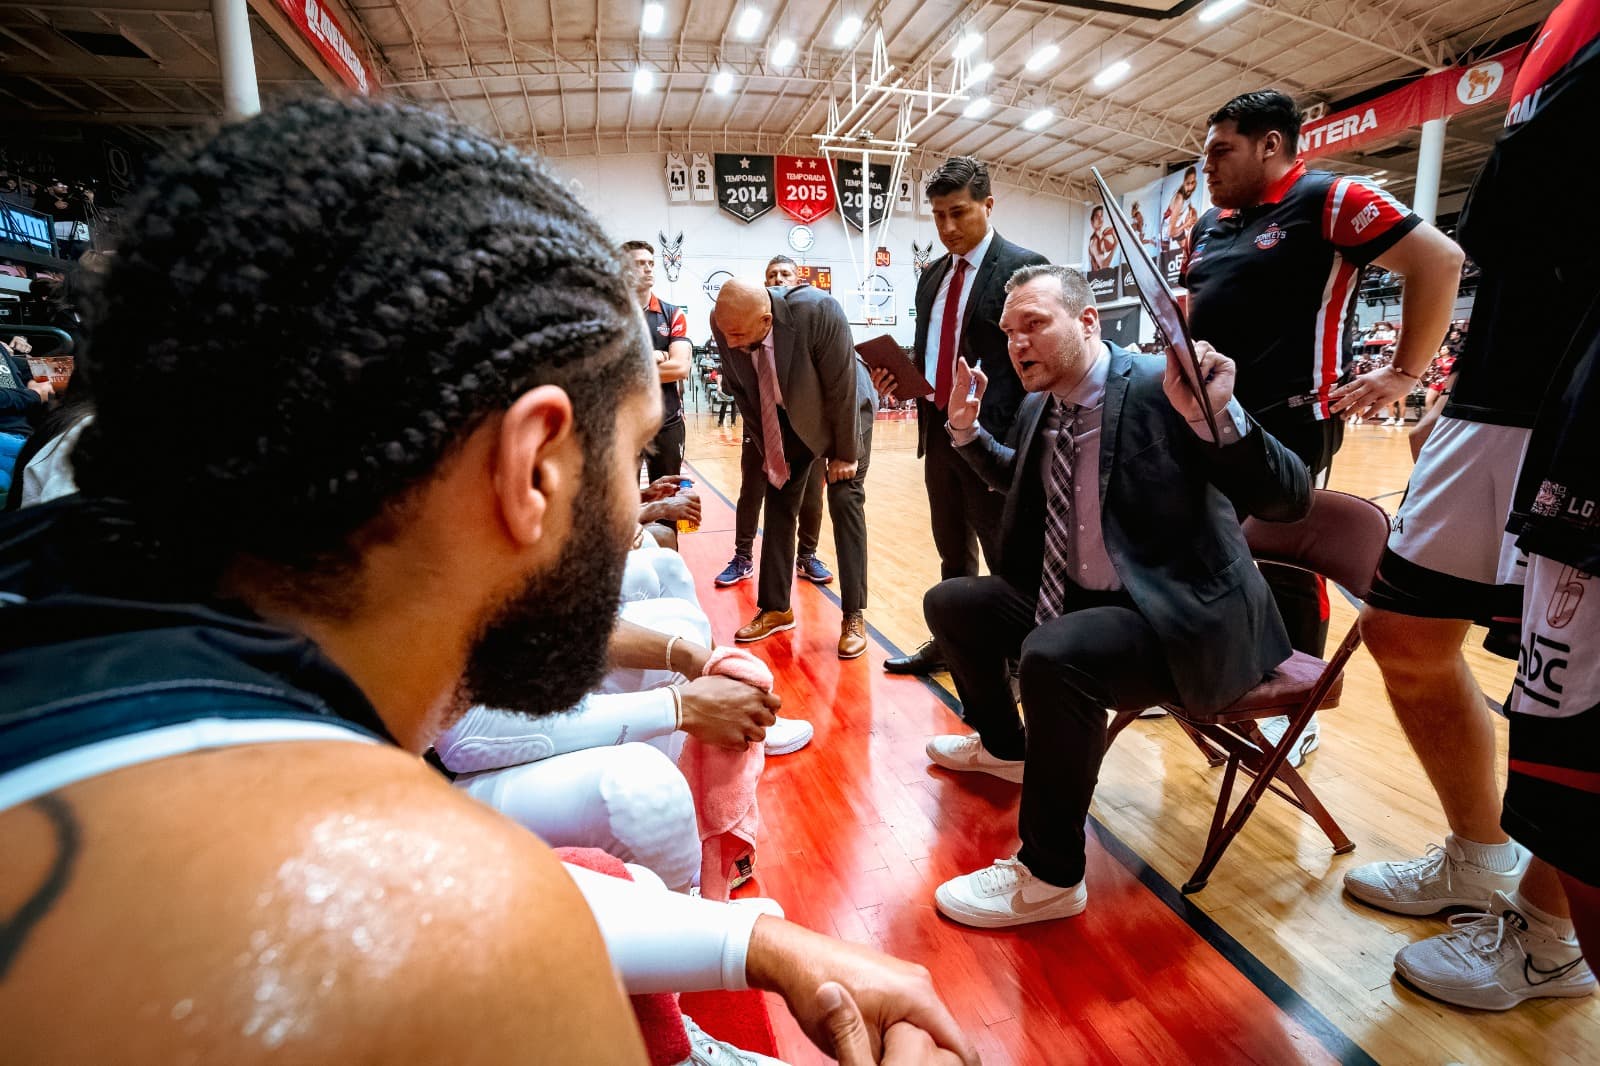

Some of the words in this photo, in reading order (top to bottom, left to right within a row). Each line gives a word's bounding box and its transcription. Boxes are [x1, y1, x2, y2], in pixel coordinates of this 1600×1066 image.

[671, 170, 685, 185] 41
[698, 169, 706, 184] 8
[724, 174, 766, 183] TEMPORADA
[785, 172, 826, 182] TEMPORADA
[726, 186, 768, 204] 2014
[785, 184, 828, 201] 2015
[901, 183, 909, 196] 9
[1351, 202, 1381, 234] 2025
